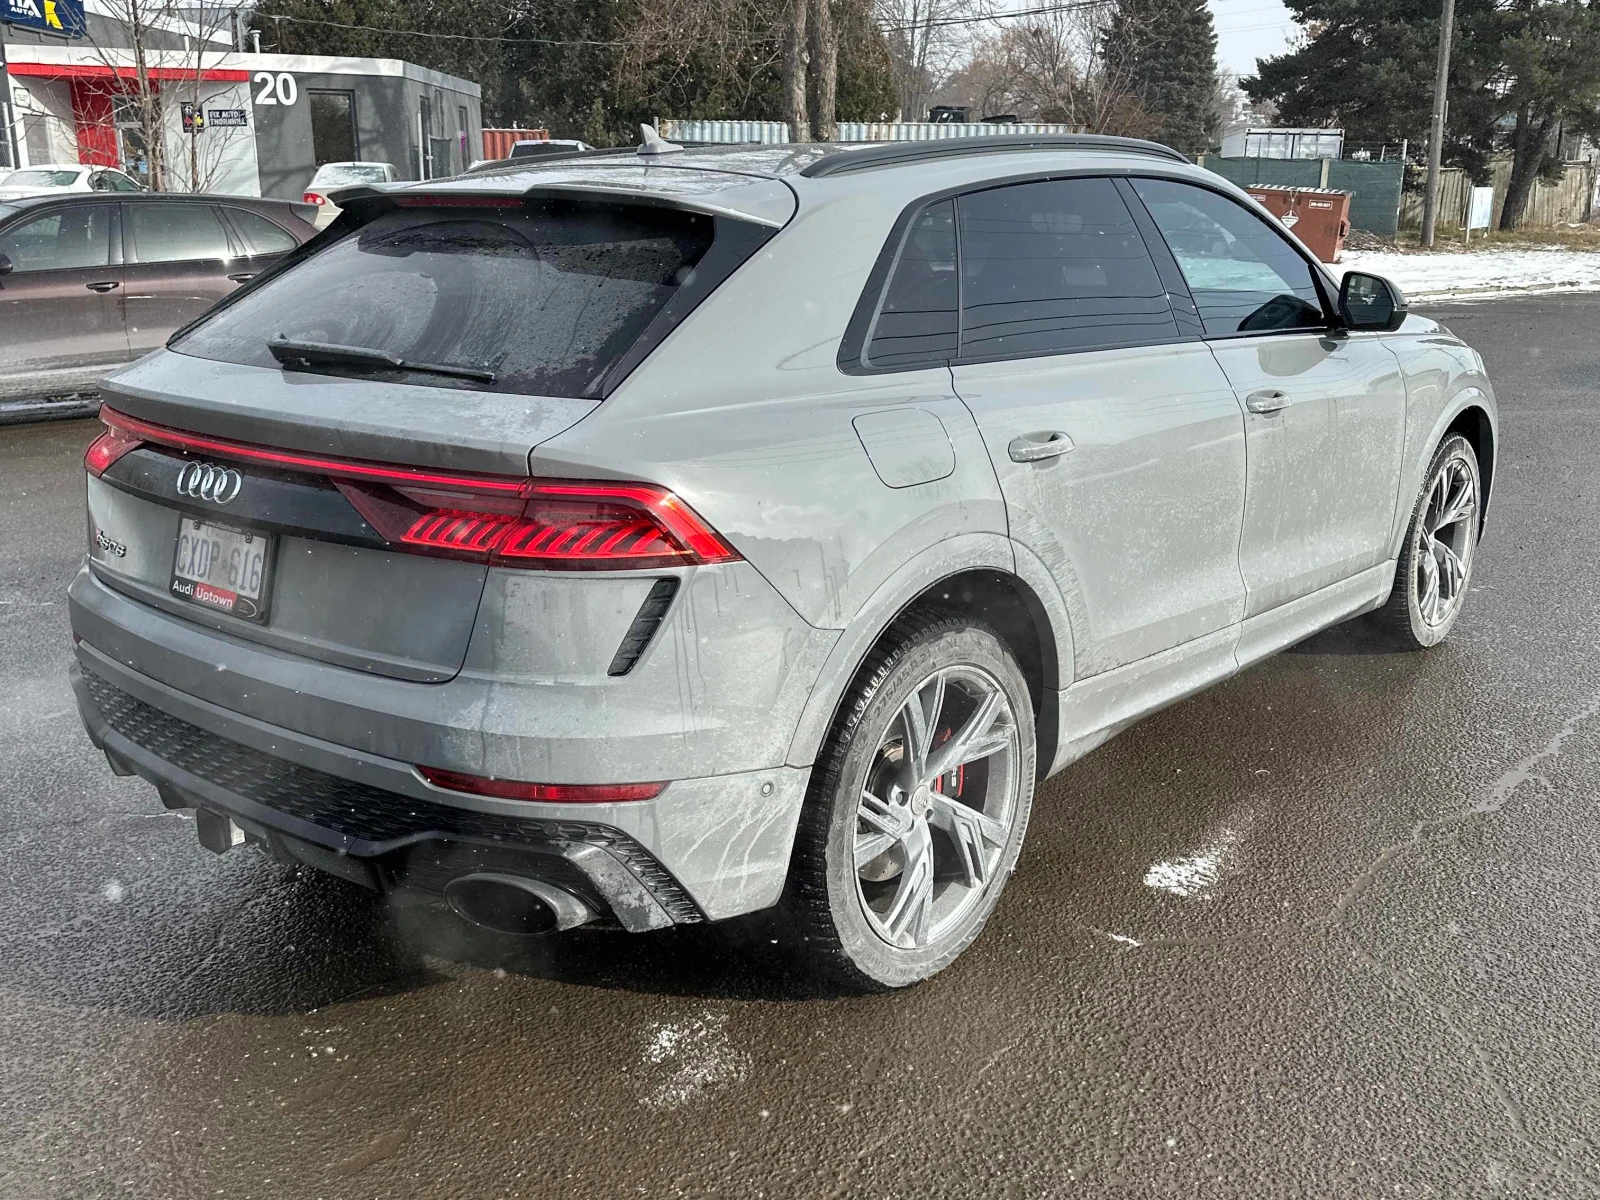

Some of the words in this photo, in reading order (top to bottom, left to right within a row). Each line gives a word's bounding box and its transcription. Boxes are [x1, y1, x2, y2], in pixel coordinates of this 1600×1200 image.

[11, 7, 35, 16] AUTO
[254, 72, 298, 105] 20
[177, 535, 220, 580] CXDP
[228, 547, 262, 592] 616
[172, 580, 194, 595] Audi
[196, 587, 233, 608] Uptown
